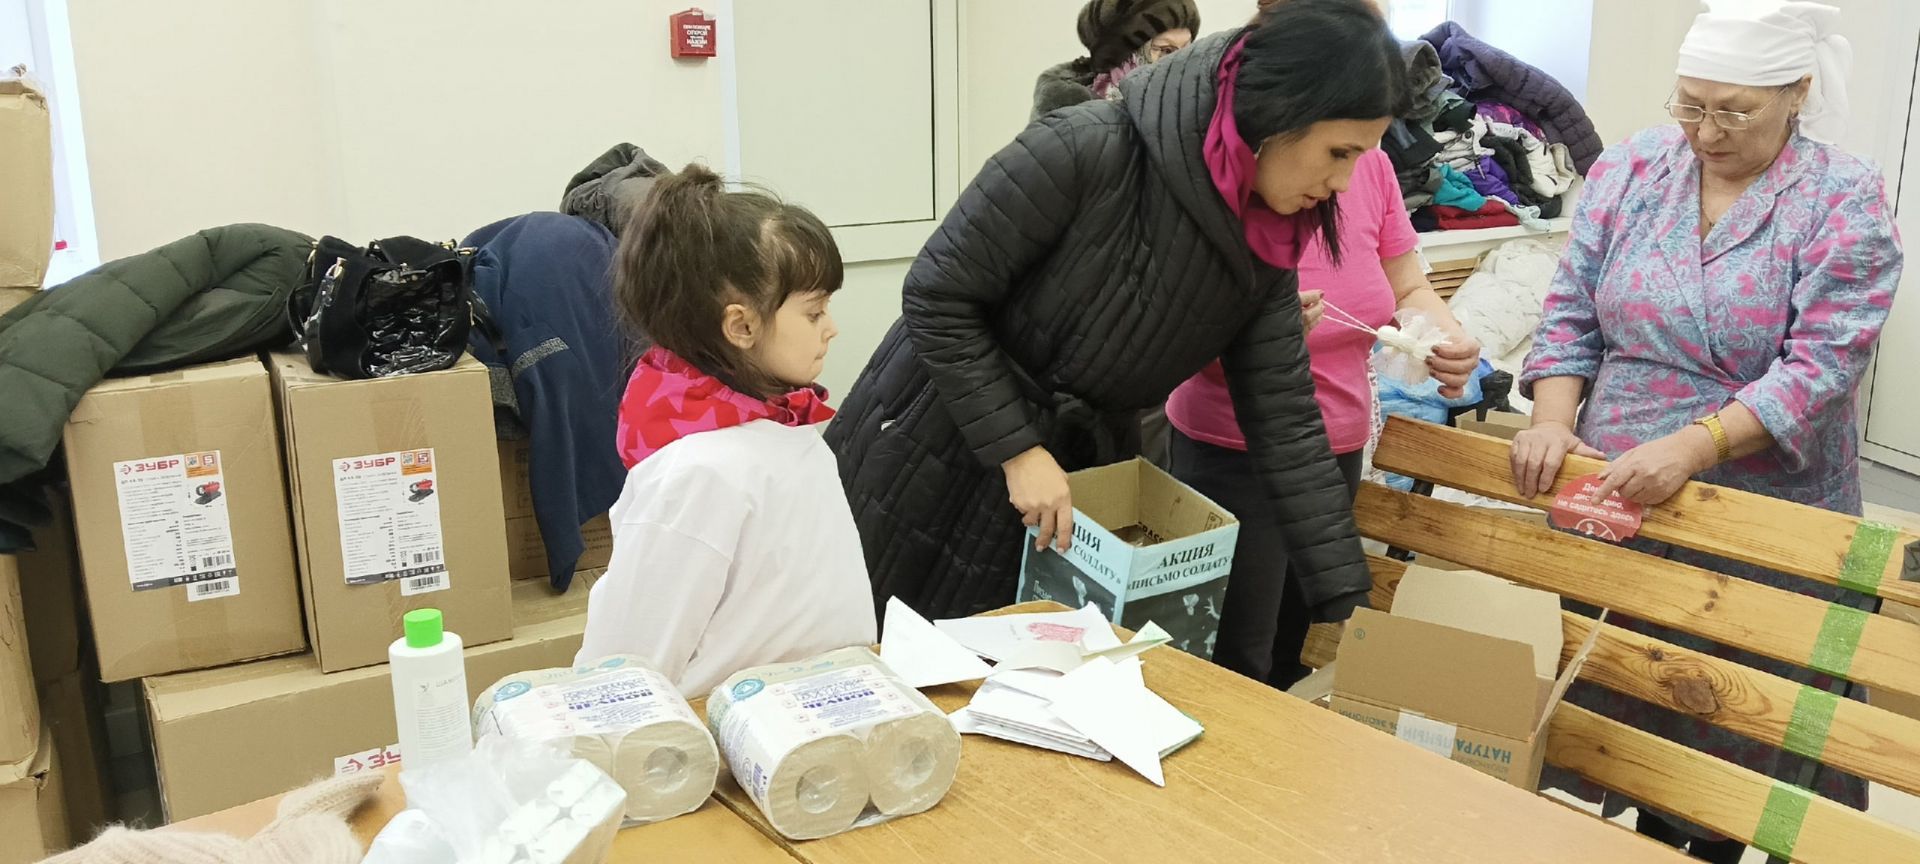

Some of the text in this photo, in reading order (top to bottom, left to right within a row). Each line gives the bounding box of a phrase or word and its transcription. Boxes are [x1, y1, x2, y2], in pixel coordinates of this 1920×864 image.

[135, 459, 180, 472] ЗУБР
[353, 457, 396, 470] ЗУБР
[1557, 499, 1568, 507] не
[1157, 543, 1215, 569] АКЦИЯ
[1127, 569, 1181, 590] «ПИСЬМО
